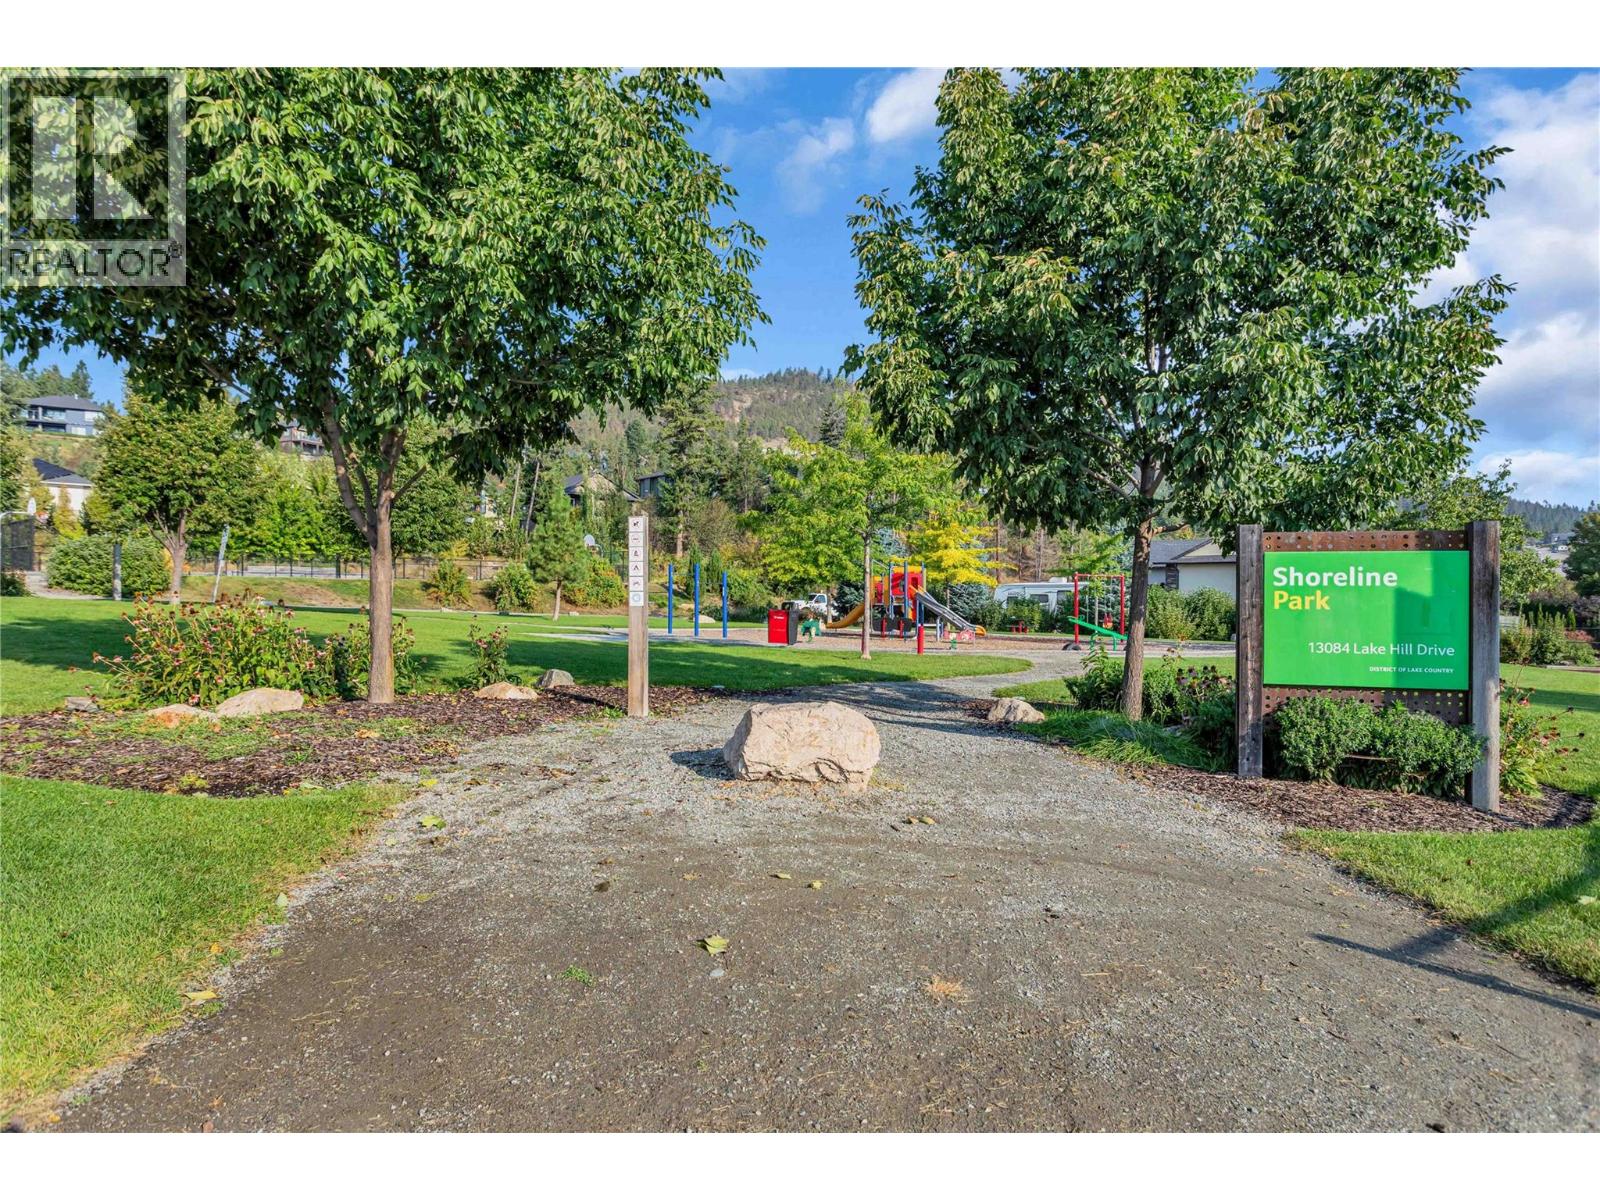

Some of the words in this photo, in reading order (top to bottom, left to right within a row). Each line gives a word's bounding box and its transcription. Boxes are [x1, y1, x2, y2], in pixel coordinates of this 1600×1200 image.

[1272, 566, 1398, 587] Shoreline
[1273, 590, 1330, 610] Park
[1308, 642, 1350, 654] 13084
[1353, 642, 1386, 655] Lake
[1389, 643, 1413, 656] Hill
[1417, 643, 1455, 656] Drive
